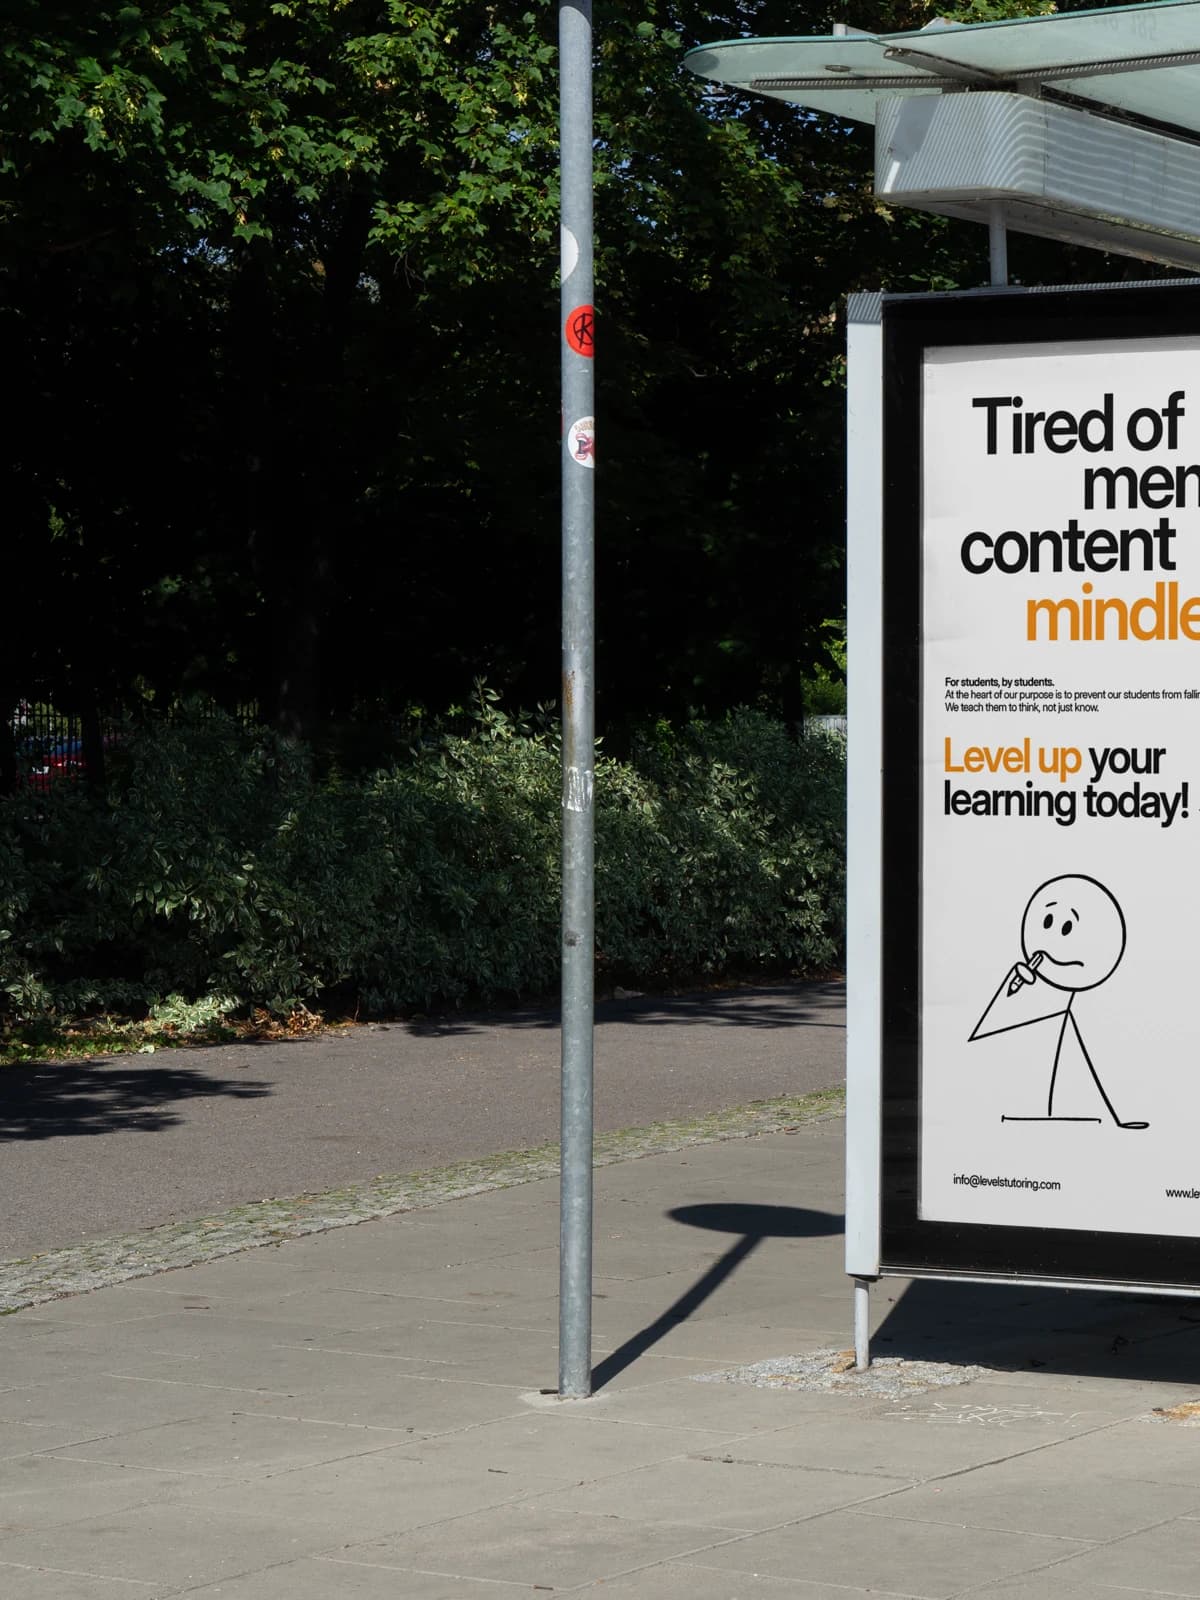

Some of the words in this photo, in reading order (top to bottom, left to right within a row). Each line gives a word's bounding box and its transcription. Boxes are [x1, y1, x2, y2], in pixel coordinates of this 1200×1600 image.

[972, 393, 1113, 455] Tired
[1127, 391, 1185, 451] of
[961, 518, 1176, 574] content
[945, 678, 960, 687] For
[961, 678, 1001, 688] students,
[1002, 678, 1013, 688] by
[1014, 678, 1055, 687] students.
[945, 689, 954, 699] At
[956, 689, 969, 699] the
[970, 690, 992, 699] heart
[993, 689, 1003, 699] of
[1019, 692, 1054, 701] purpose
[1055, 689, 1062, 699] is
[1064, 690, 1073, 699] to
[1074, 690, 1106, 701] prevent
[1123, 690, 1160, 699] students
[1162, 689, 1182, 699] from
[945, 702, 959, 712] We
[960, 702, 984, 712] teach
[985, 702, 1007, 712] them
[1008, 703, 1018, 712] to
[1018, 702, 1041, 713] think,
[1042, 703, 1057, 712] not
[1058, 702, 1073, 714] just
[1075, 702, 1099, 712] know.
[944, 737, 1030, 773] Level
[1039, 747, 1082, 783] up
[1088, 748, 1166, 783] your
[943, 779, 1076, 827] learning
[1083, 782, 1189, 828] today!
[953, 1173, 1061, 1192] info@levelstutoring.com
